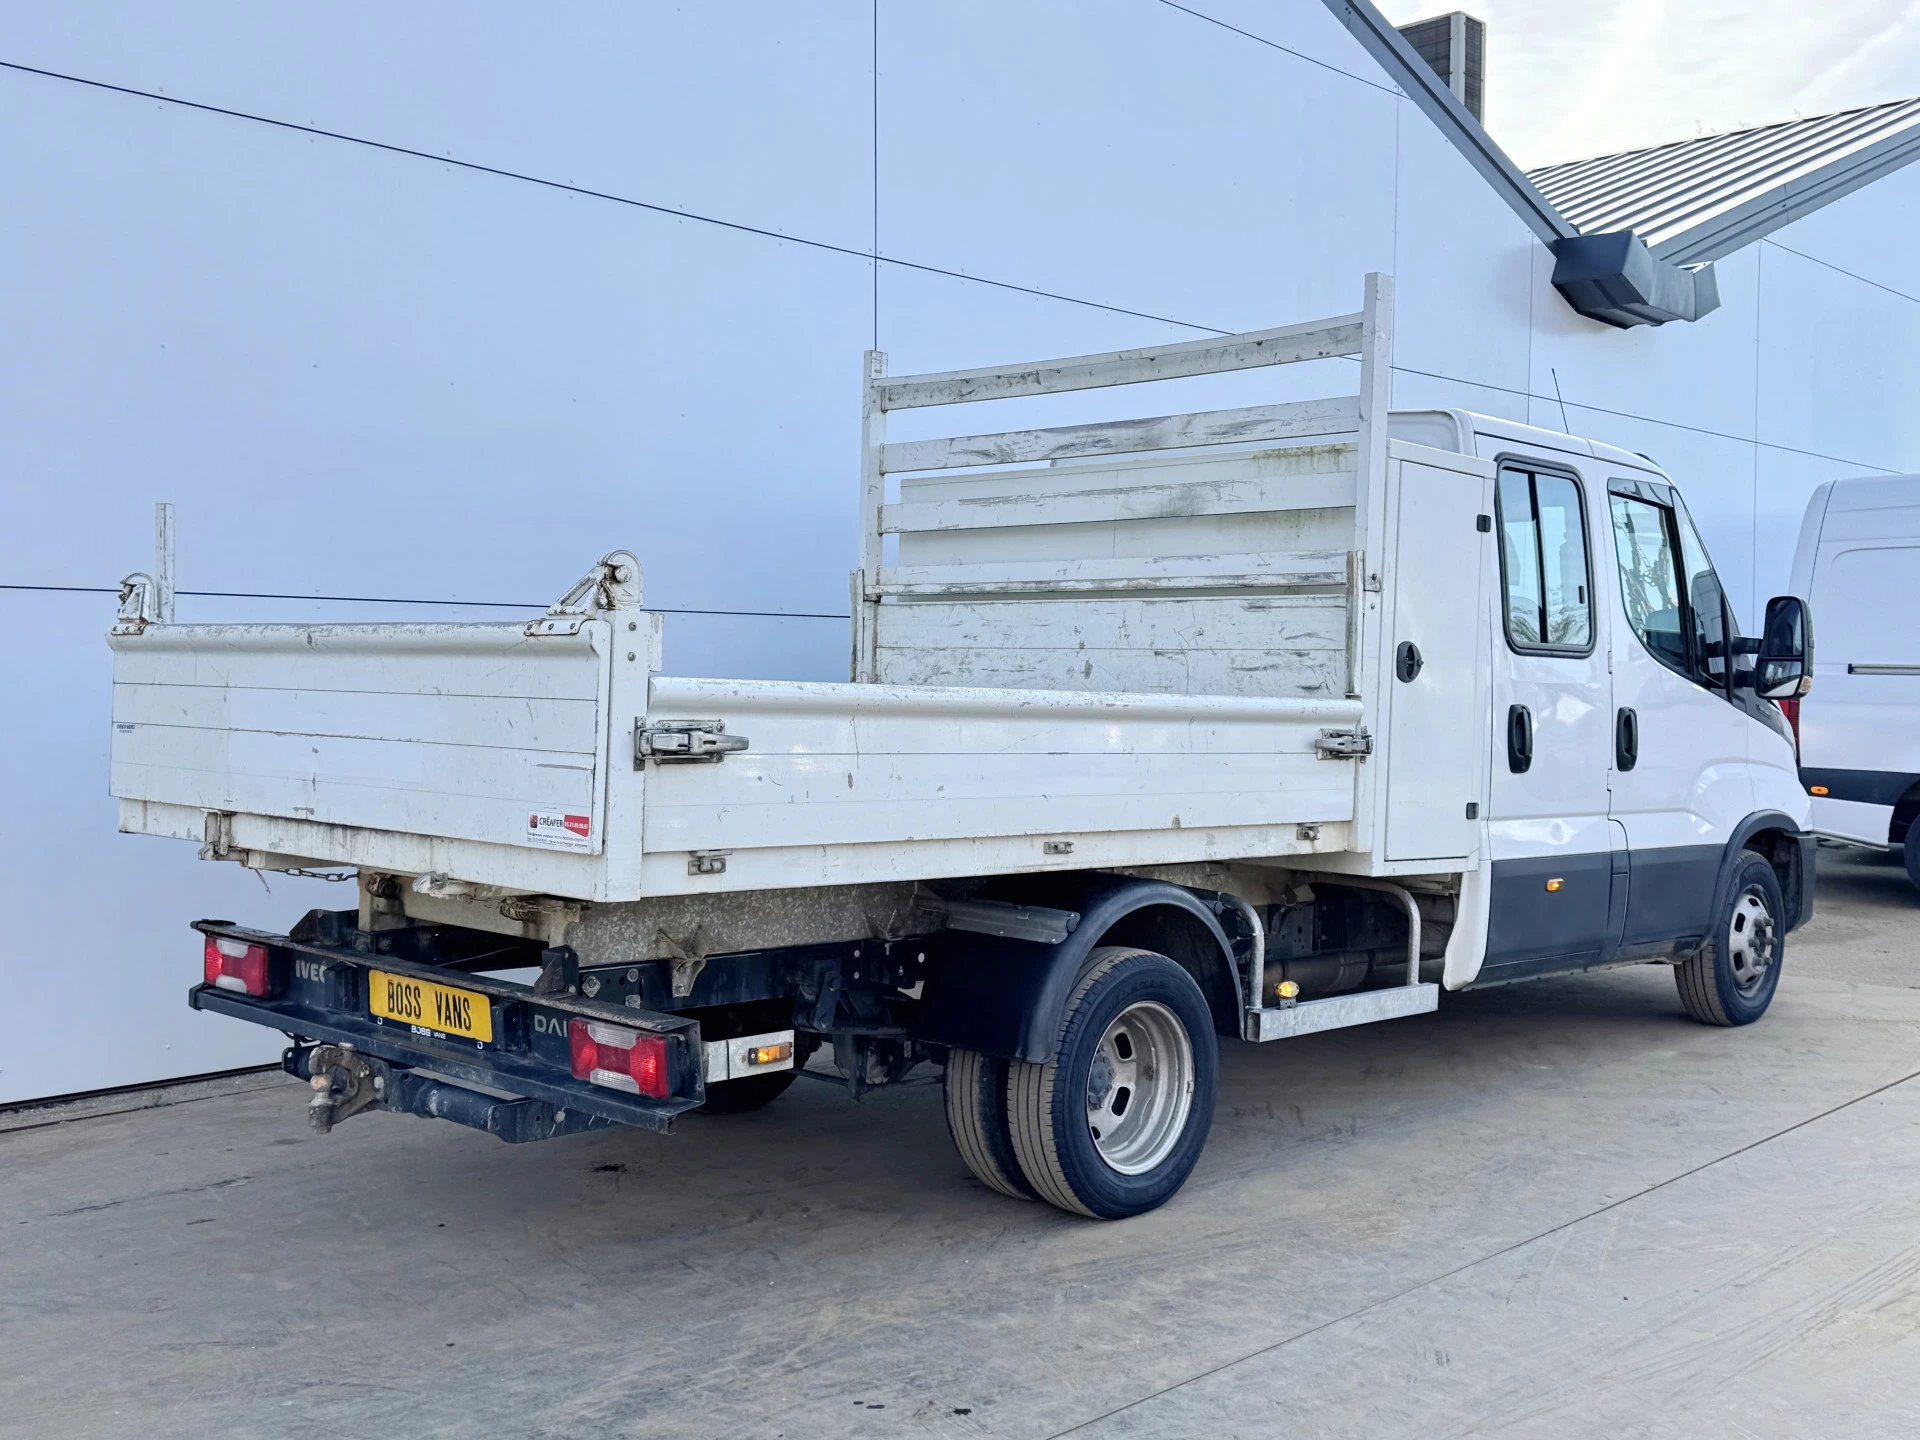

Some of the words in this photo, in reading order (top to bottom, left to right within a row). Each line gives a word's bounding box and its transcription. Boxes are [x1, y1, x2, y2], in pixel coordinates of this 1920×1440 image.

[295, 959, 328, 984] IVEC
[387, 980, 422, 1020] BOSS
[434, 990, 472, 1032] VANS
[411, 1024, 432, 1037] BOSS
[534, 1014, 568, 1038] DAI
